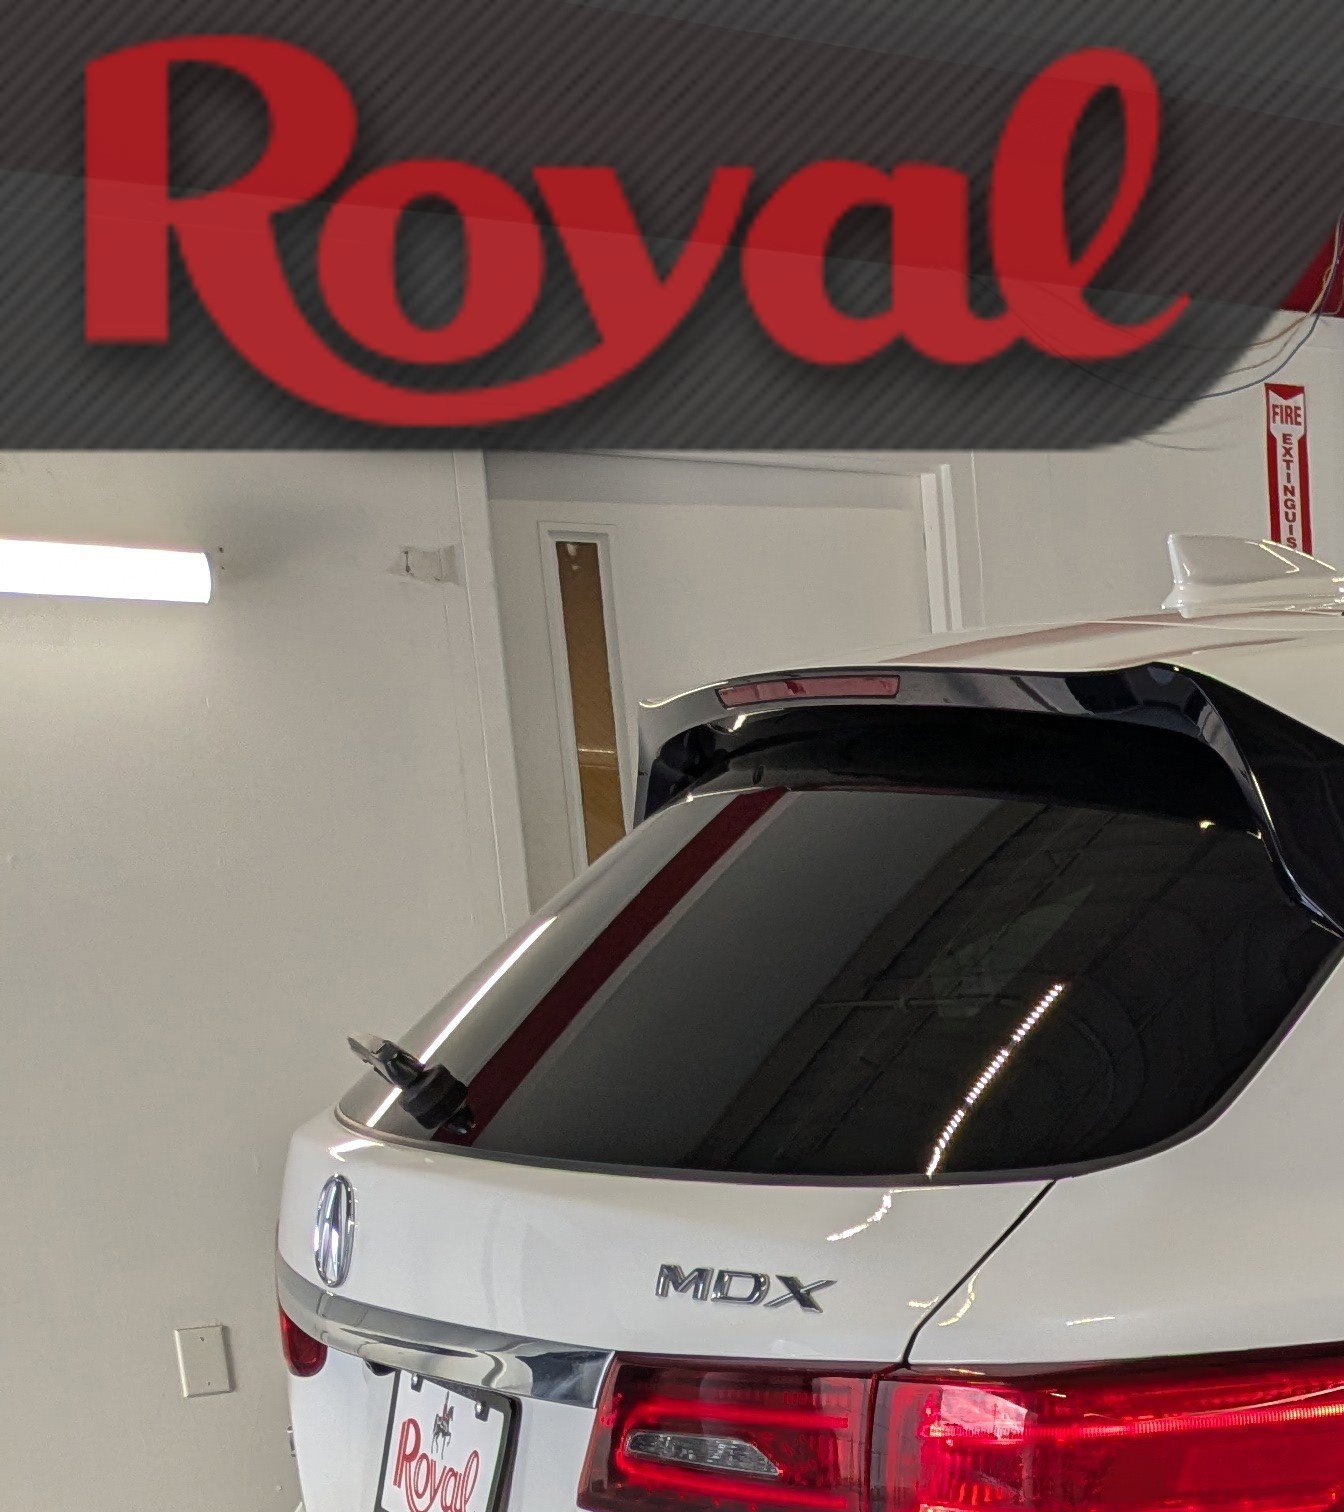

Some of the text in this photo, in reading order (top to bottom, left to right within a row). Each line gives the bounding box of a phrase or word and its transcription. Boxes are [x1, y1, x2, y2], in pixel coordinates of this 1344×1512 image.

[1271, 403, 1302, 426] FIRE
[1281, 432, 1298, 550] EXTINGUIS
[655, 1263, 838, 1313] MDX
